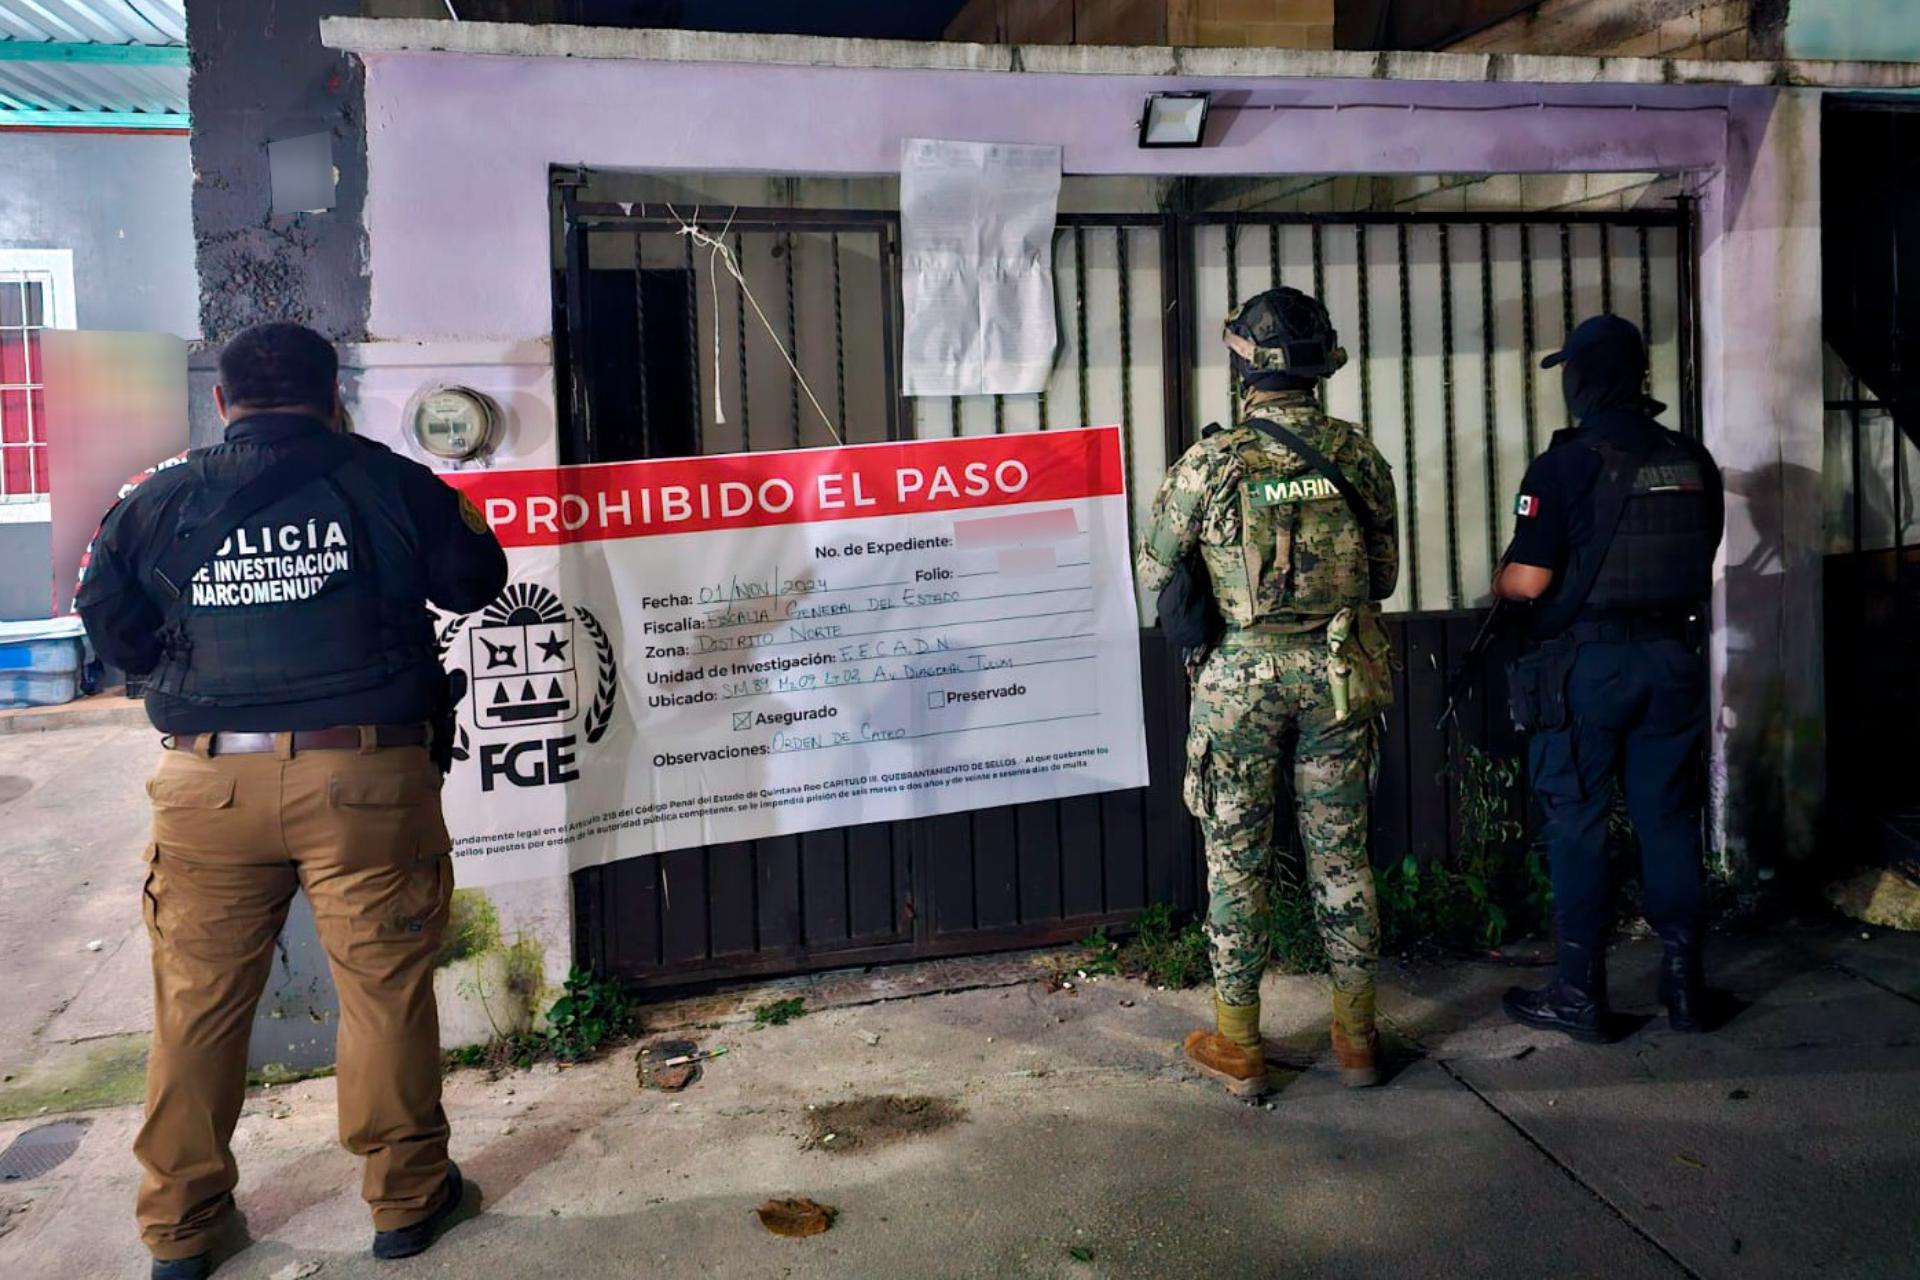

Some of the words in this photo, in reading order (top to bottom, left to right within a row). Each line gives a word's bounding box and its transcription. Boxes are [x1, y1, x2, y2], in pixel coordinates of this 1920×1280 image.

[485, 478, 794, 534] PROHIBIDO
[816, 472, 876, 510] EL
[896, 459, 1029, 504] PASO
[1264, 478, 1340, 502] MARIN
[216, 518, 348, 556] LICÍA
[815, 545, 840, 559] No.
[843, 542, 864, 556] de
[867, 537, 953, 557] Expediente:
[214, 548, 348, 582] INVESTIGACIÓN
[915, 568, 953, 583] Folio:
[192, 576, 329, 606] NARCOMENUD
[642, 593, 693, 610] Fecha:
[644, 616, 705, 634] Fiscalía:
[645, 646, 690, 658] Zona:
[647, 668, 704, 685] Unidad
[707, 665, 728, 678] de
[732, 652, 836, 675] Investigación:
[648, 690, 717, 708] Ubicado:
[947, 683, 1026, 703] Preservado
[755, 706, 837, 726] Asegurado
[479, 735, 579, 792] FGE
[653, 744, 770, 767] Observaciones:
[516, 827, 541, 839] legal
[618, 808, 634, 818] del
[971, 762, 983, 771] DE
[527, 839, 544, 850] por
